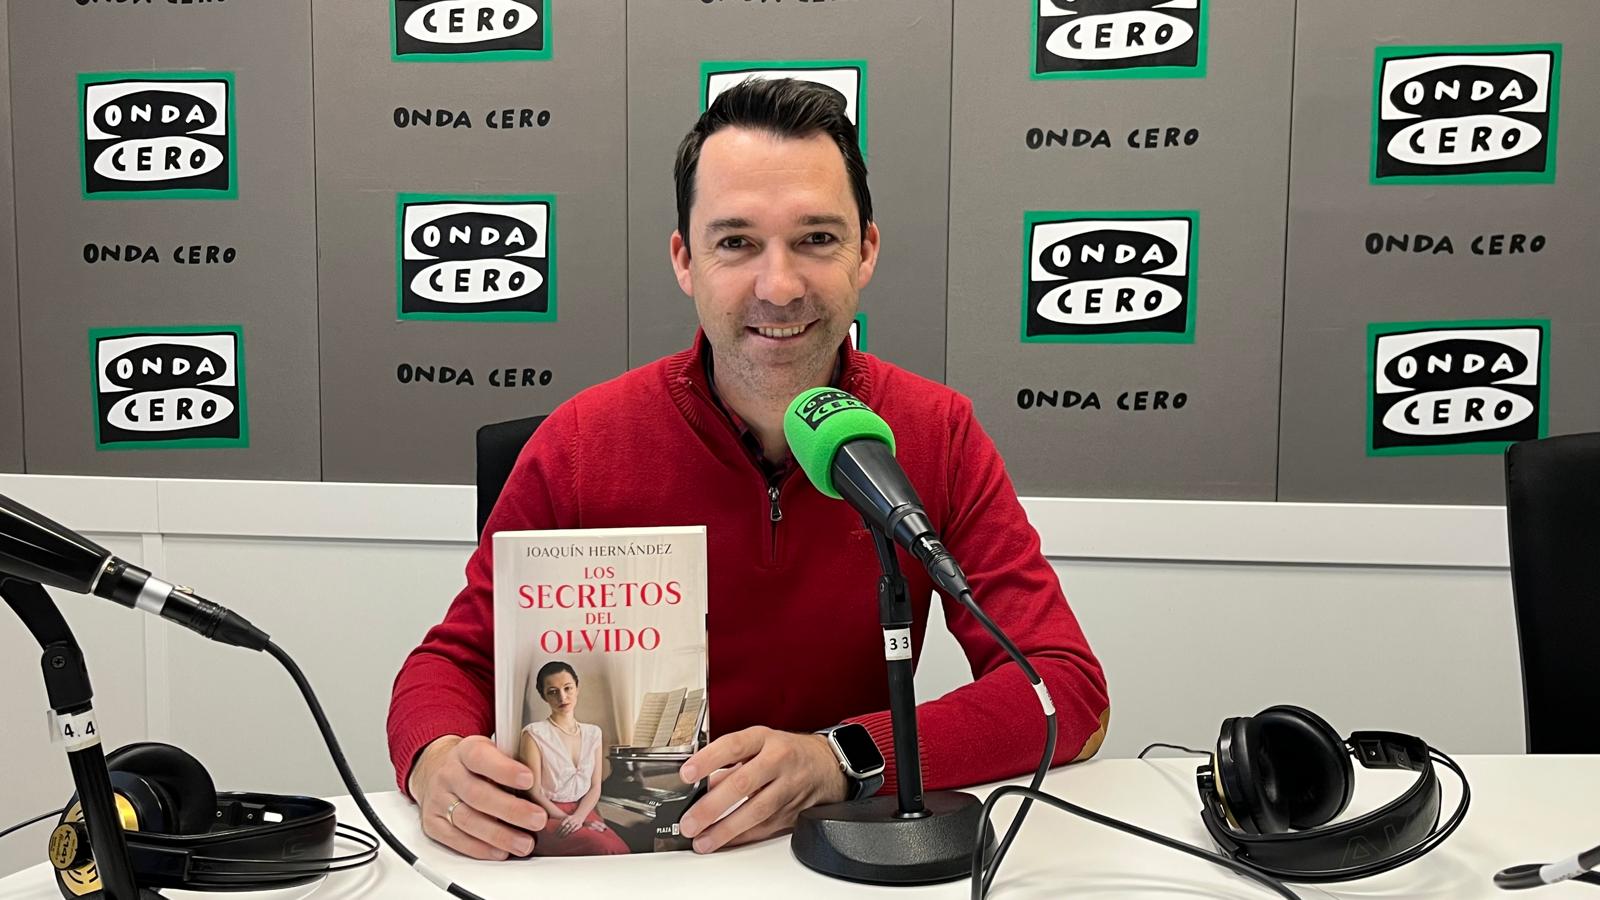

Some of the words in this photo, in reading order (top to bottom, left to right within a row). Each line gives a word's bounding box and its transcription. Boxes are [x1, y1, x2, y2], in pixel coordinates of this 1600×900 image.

[423, 8, 519, 33] CERO
[1067, 22, 1173, 49] CERO
[1404, 80, 1523, 105] ONDA
[105, 104, 205, 126] ONDA
[394, 107, 471, 128] ONDA
[486, 109, 550, 129] CERO
[1026, 128, 1111, 149] ONDA
[1128, 128, 1198, 148] CERO
[1410, 127, 1520, 153] CERO
[112, 147, 205, 171] CERO
[423, 226, 525, 247] ONDA
[1366, 233, 1453, 254] ONDA
[1471, 234, 1545, 255] CERO
[84, 244, 159, 263] ONDA
[174, 246, 236, 264] CERO
[1052, 244, 1163, 267] ONDA
[429, 269, 525, 292] CERO
[1057, 288, 1162, 314] CERO
[117, 357, 215, 379] ONDA
[397, 364, 474, 385] ONDA
[489, 369, 552, 387] CERO
[1398, 353, 1513, 379] ONDA
[125, 398, 216, 422] CERO
[1017, 389, 1100, 409] ONDA
[1117, 391, 1187, 410] CERO
[1404, 398, 1513, 425] CERO
[526, 544, 584, 558] JOAQUÍN
[589, 542, 673, 557] HERNÁNDEZ
[584, 566, 615, 580] LOS
[518, 581, 682, 609] SECRETOS
[585, 612, 616, 625] DEL
[540, 627, 661, 655] OLVIDO
[656, 826, 671, 834] PLAZA
